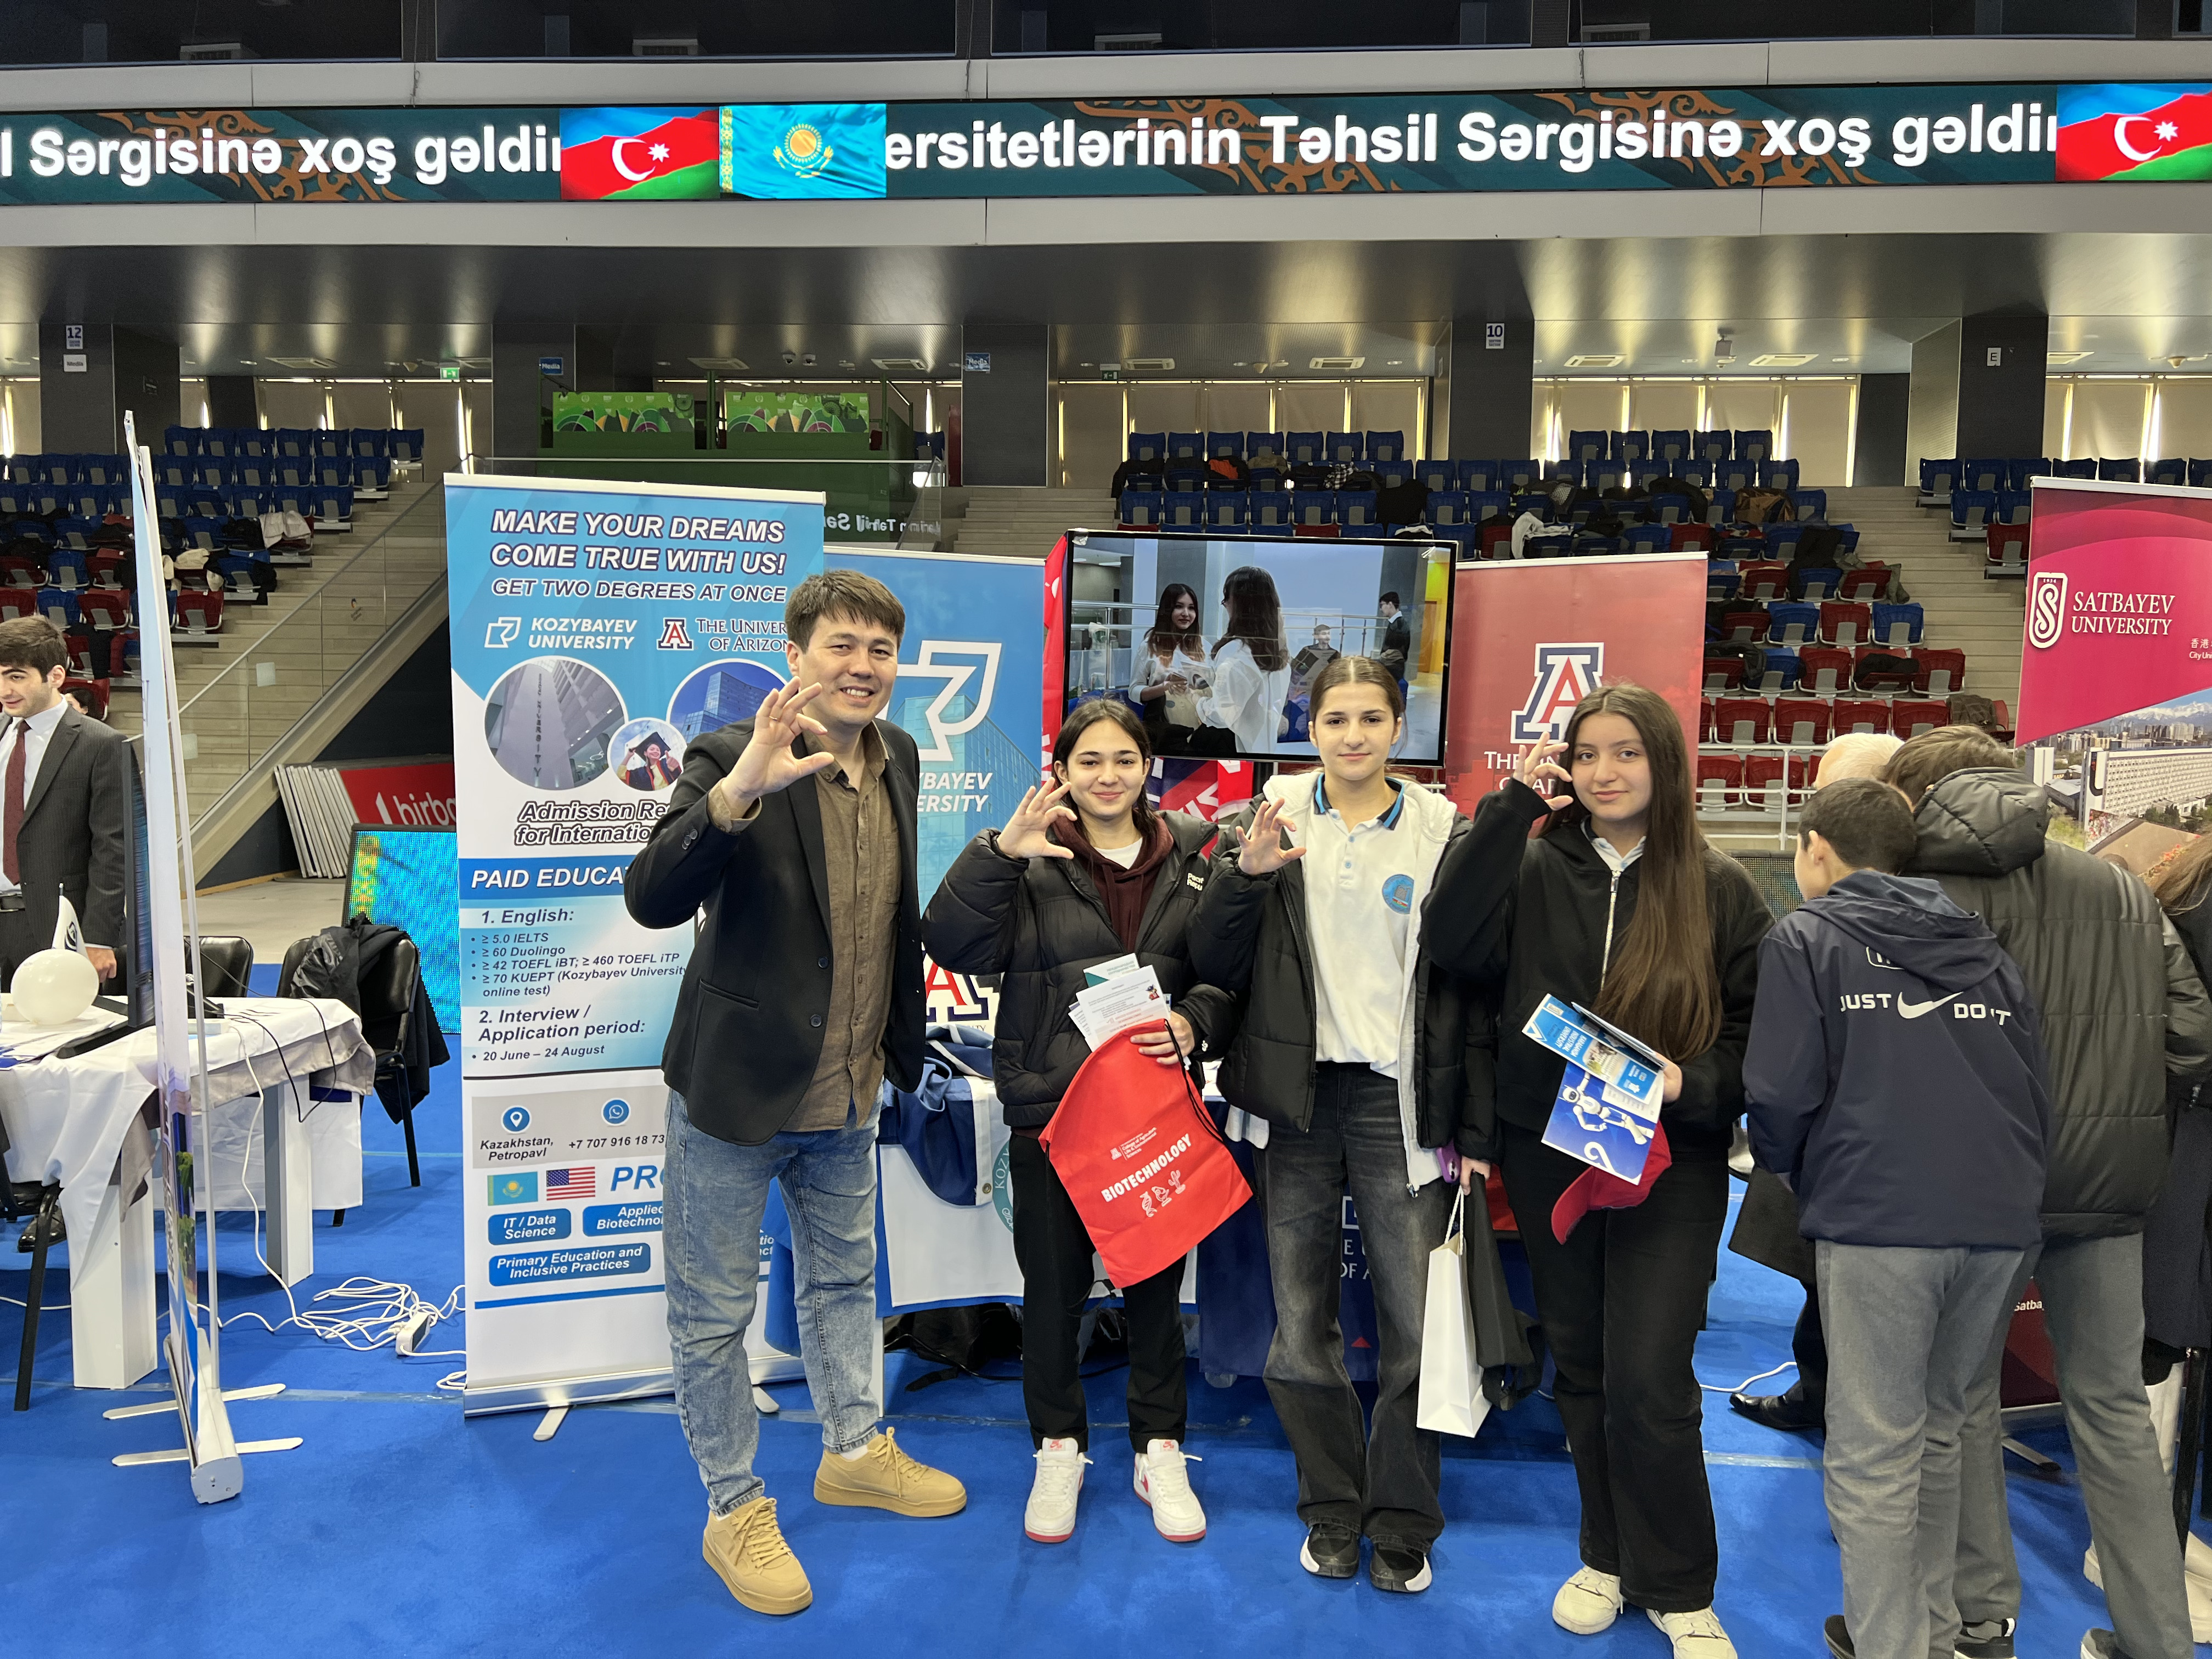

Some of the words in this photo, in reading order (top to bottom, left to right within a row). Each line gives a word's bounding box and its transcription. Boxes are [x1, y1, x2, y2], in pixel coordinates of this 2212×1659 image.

[1260, 113, 1437, 165] Təhsil
[1456, 109, 1743, 173] Sərgisinə
[1760, 116, 1872, 168] xoş
[29, 127, 283, 187] Sərgisinə
[298, 136, 397, 185] xoş
[67, 327, 82, 338] 12
[1487, 325, 1503, 337] 10
[1990, 352, 1997, 361] E
[492, 510, 577, 535] MAKE
[584, 513, 664, 538] YOUR
[670, 517, 786, 543] DREAMS
[491, 544, 577, 569] COME
[584, 547, 661, 571] TRUE
[667, 550, 734, 572] WITH
[741, 552, 787, 575] US!
[492, 579, 537, 597] GET
[542, 580, 590, 597] TWO
[595, 582, 695, 601] DEGREES
[699, 584, 726, 601] AT
[731, 585, 787, 603] ONCE
[2073, 591, 2175, 615] SATBAYEV
[531, 617, 637, 635] KOZYBAYEV
[696, 618, 726, 633] THE
[731, 619, 786, 634] UNIVER
[2072, 616, 2172, 636] UNIVERSITY
[528, 634, 635, 650] UNIVERSITY
[709, 637, 730, 651] OF
[733, 636, 788, 652] ARIZO
[919, 772, 992, 790] YBAYEV
[519, 800, 633, 823] Admission
[917, 794, 989, 812] ERSITY
[514, 825, 550, 845] for
[551, 823, 651, 845] Internatio
[471, 869, 529, 889] PAID
[537, 866, 629, 887] EDUCA
[482, 911, 495, 924] 1.
[501, 909, 574, 926] English:
[493, 934, 510, 944] 5.0
[513, 933, 549, 943] IELTS
[493, 947, 507, 957] 60
[510, 946, 566, 958] Duolingo
[492, 961, 507, 970] 42
[511, 959, 552, 969] TOEFL
[555, 957, 579, 969] iBT;
[592, 956, 614, 966] 460
[618, 954, 657, 964] TOEFL
[661, 953, 680, 963] iTP
[493, 974, 507, 984] 70
[510, 971, 555, 983] KUEPT
[557, 969, 627, 984] (Kozybayev
[482, 986, 521, 997] online
[523, 985, 551, 997] test)
[1840, 994, 1892, 1012] JUST
[1954, 1003, 1986, 1019] DO
[479, 1010, 493, 1024] 2.
[499, 1007, 580, 1023] Interview
[478, 1024, 579, 1044] Application
[584, 1020, 645, 1039] period:
[483, 1052, 498, 1062] 20
[500, 1050, 531, 1061] June
[545, 1047, 558, 1058] 24
[561, 1045, 605, 1059] August
[480, 1136, 554, 1150] Kazakhstan,
[568, 1139, 583, 1149] +7
[586, 1138, 607, 1148] 707
[610, 1137, 631, 1147] 916
[635, 1136, 648, 1146] 18
[651, 1135, 664, 1144] 73
[488, 1147, 546, 1162] Petropavl
[1101, 1133, 1193, 1202] BIOTECHNOLOGY
[503, 1217, 516, 1228] IT
[518, 1217, 524, 1227] /
[527, 1214, 556, 1227] Data
[504, 1226, 556, 1240] Science
[496, 1255, 548, 1270] Primary
[550, 1249, 616, 1265] Education
[618, 1246, 642, 1257] and
[509, 1263, 568, 1279] Inclusive
[571, 1259, 630, 1273] Practices
